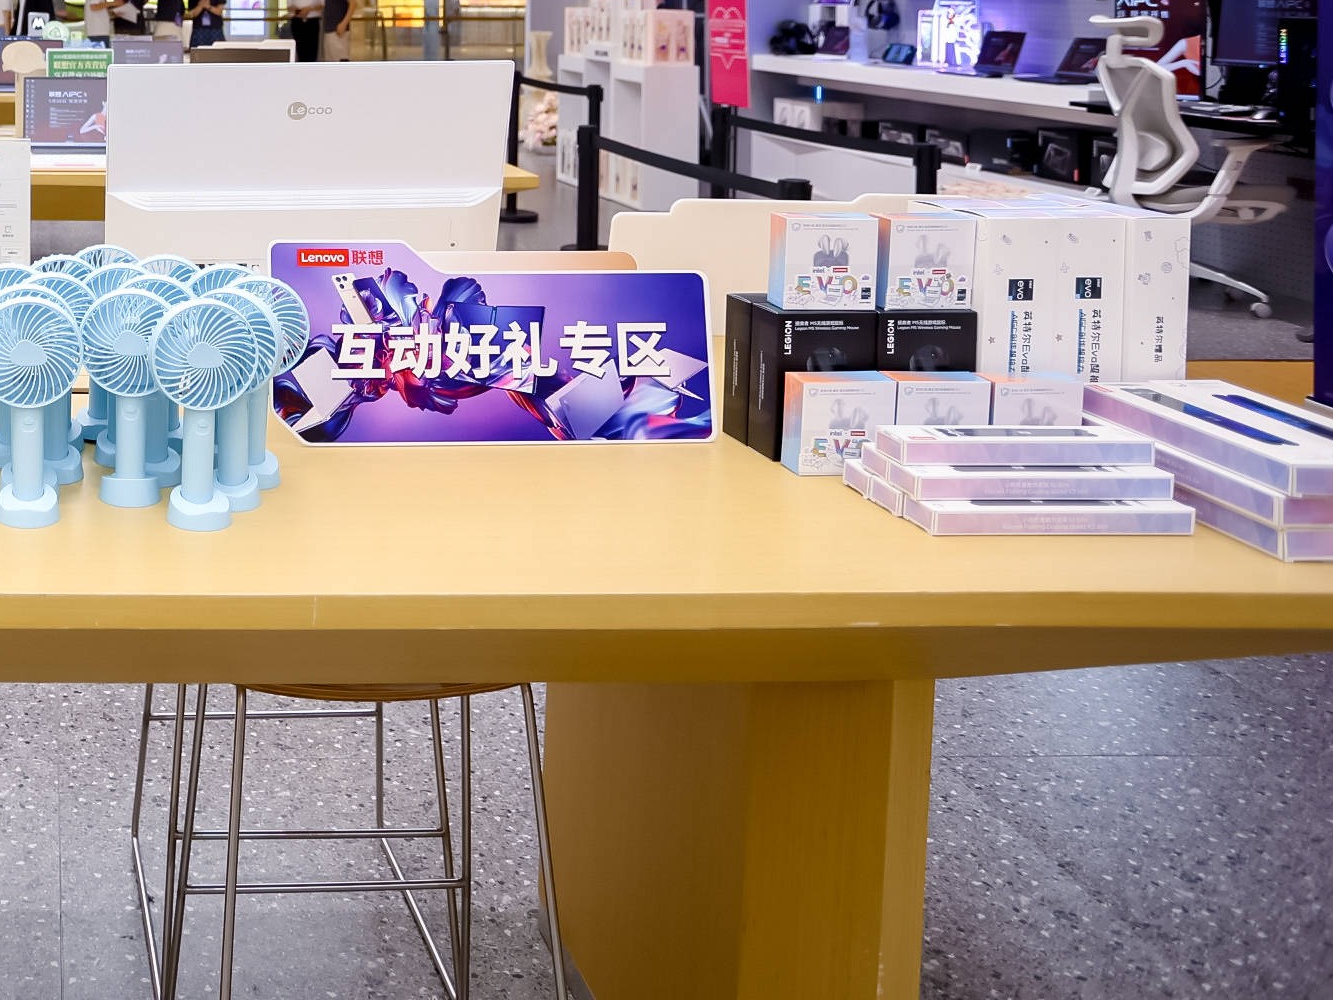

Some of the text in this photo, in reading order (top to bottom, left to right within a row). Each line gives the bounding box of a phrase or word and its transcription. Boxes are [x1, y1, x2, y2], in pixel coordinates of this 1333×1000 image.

[1279, 29, 1288, 64] LEGION
[300, 252, 345, 265] Lenovo
[351, 250, 384, 266] 联想
[1016, 280, 1024, 300] evo
[1084, 278, 1092, 298] evo
[783, 320, 792, 355] LEGION
[886, 319, 895, 354] LEGION
[331, 321, 672, 381] 互动好礼专区
